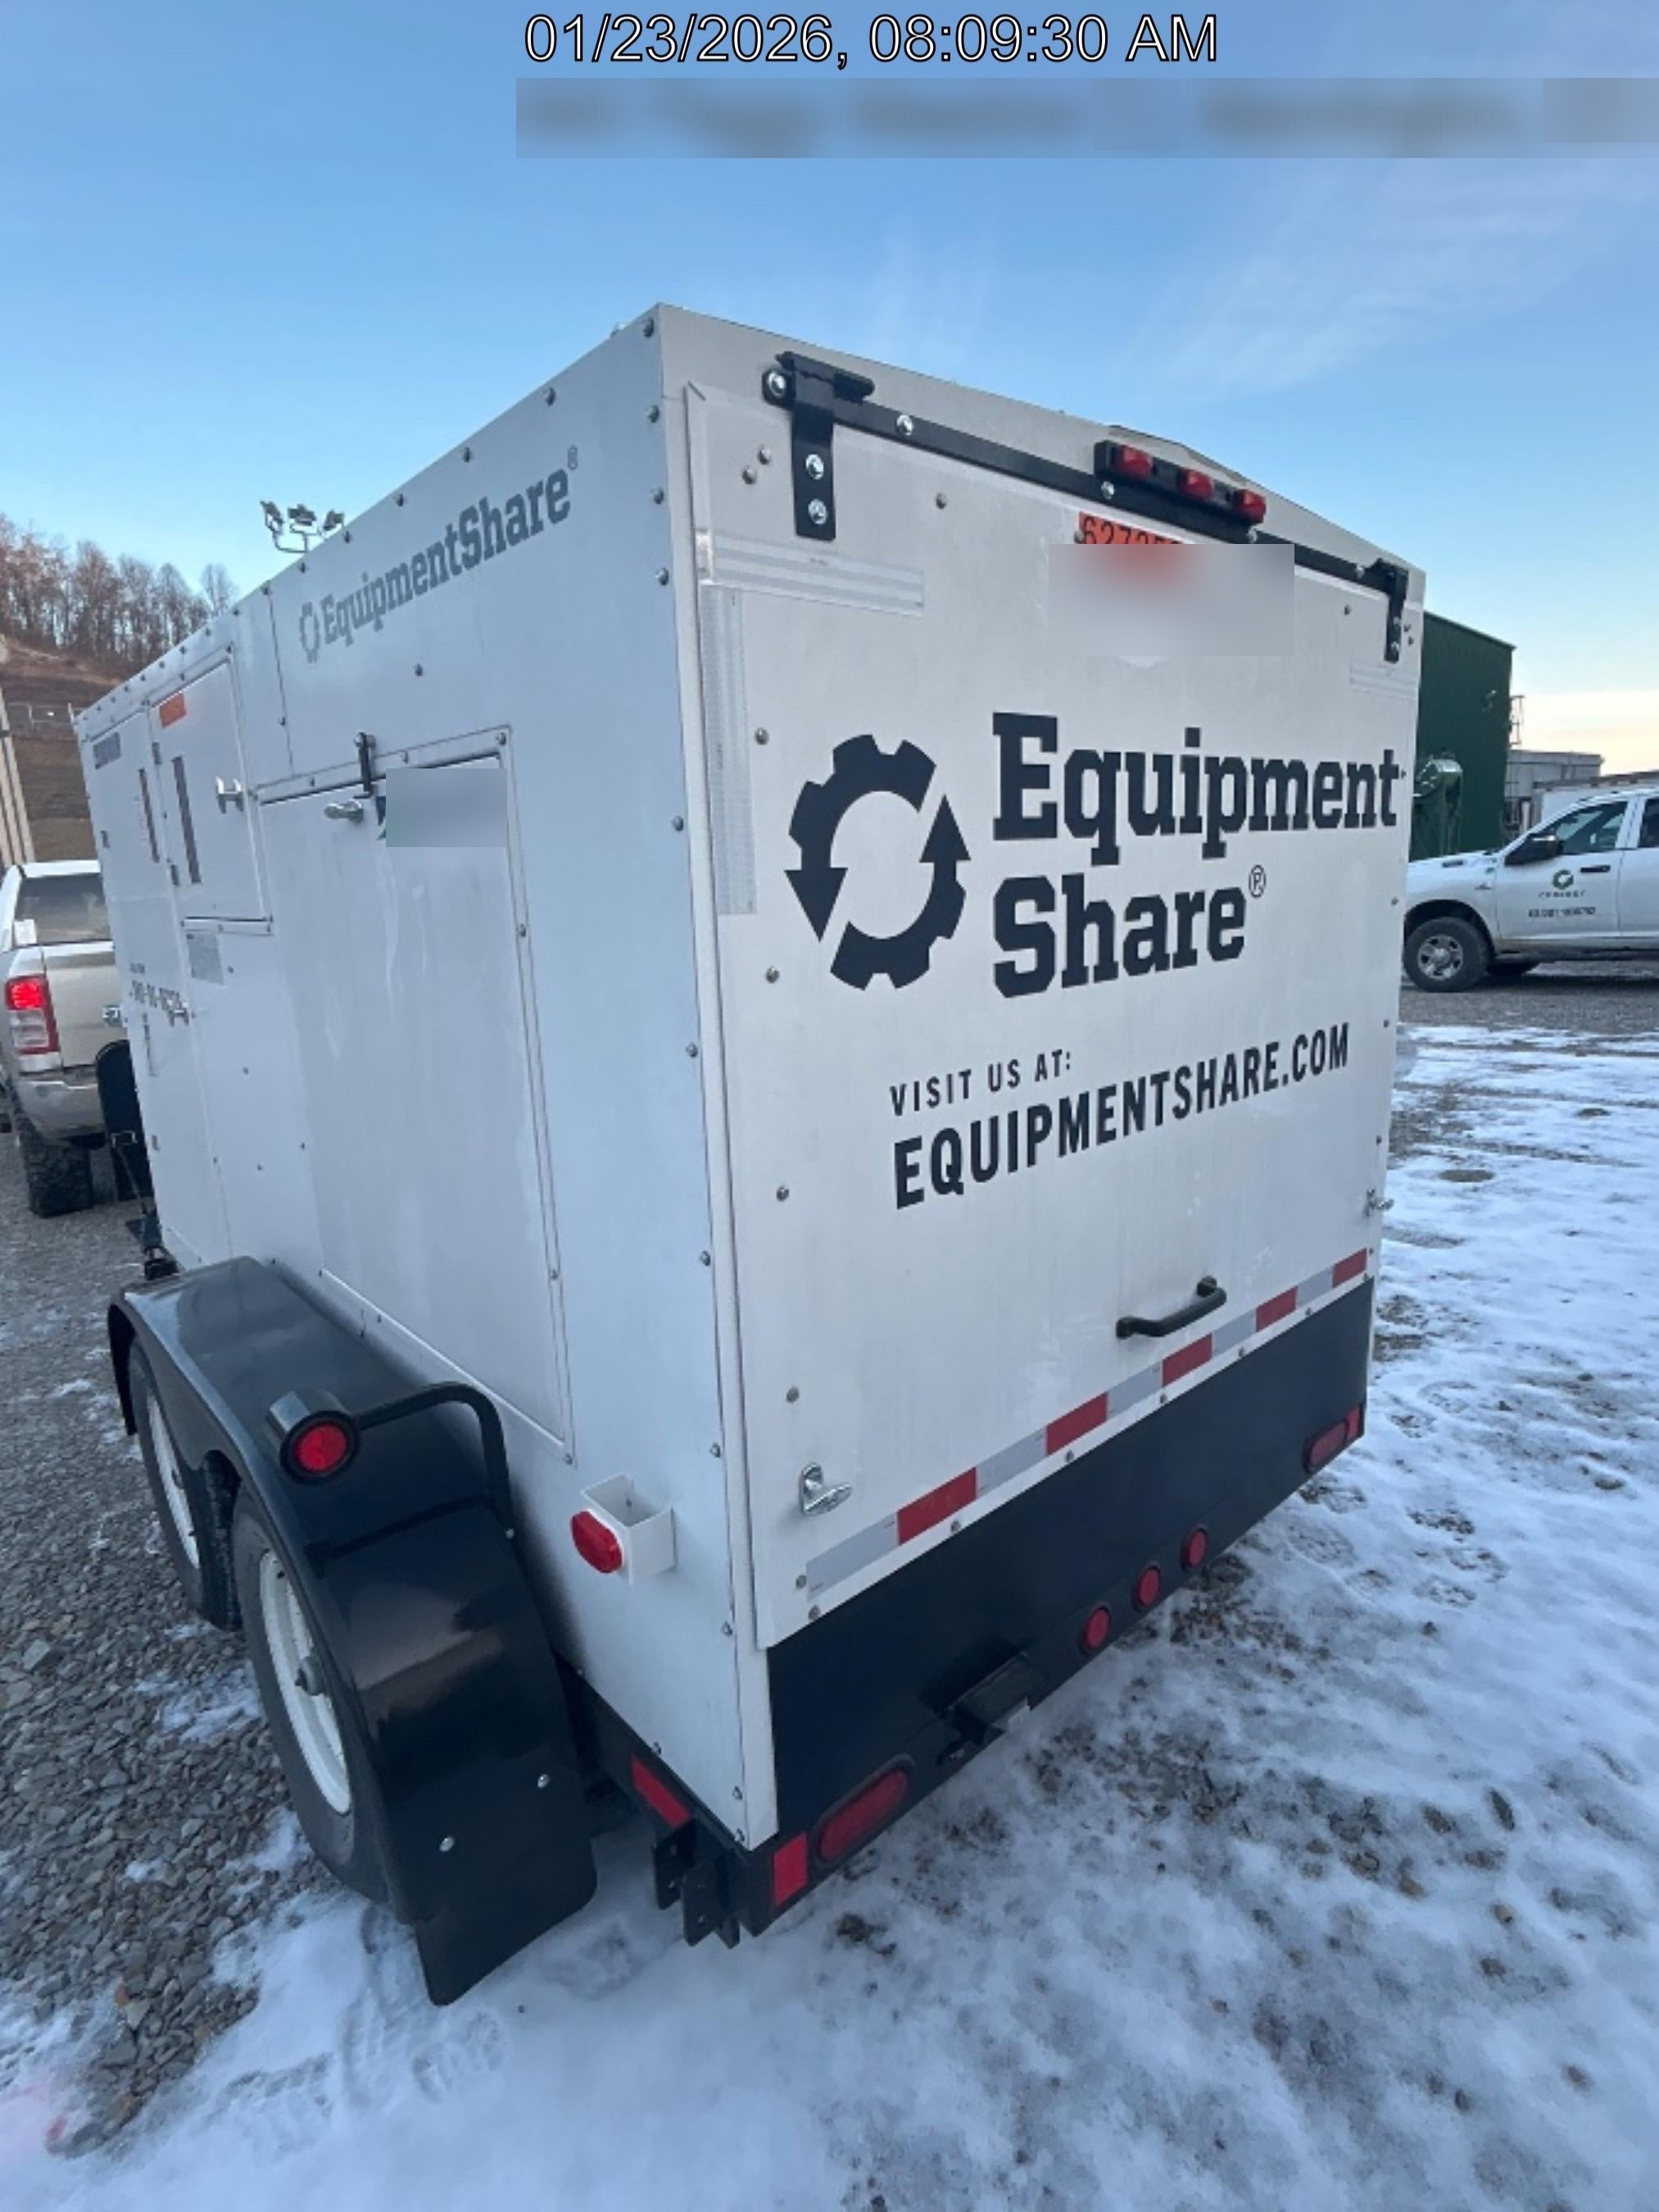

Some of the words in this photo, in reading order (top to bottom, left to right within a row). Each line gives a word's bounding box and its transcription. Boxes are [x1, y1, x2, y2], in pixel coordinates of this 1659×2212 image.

[993, 712, 1400, 867] Equipment
[890, 1068, 972, 1117] VISIT
[988, 1058, 1021, 1093] US
[1034, 1049, 1071, 1083] AT:
[894, 1022, 1349, 1209] EQUIPMENTSHARE.COM
